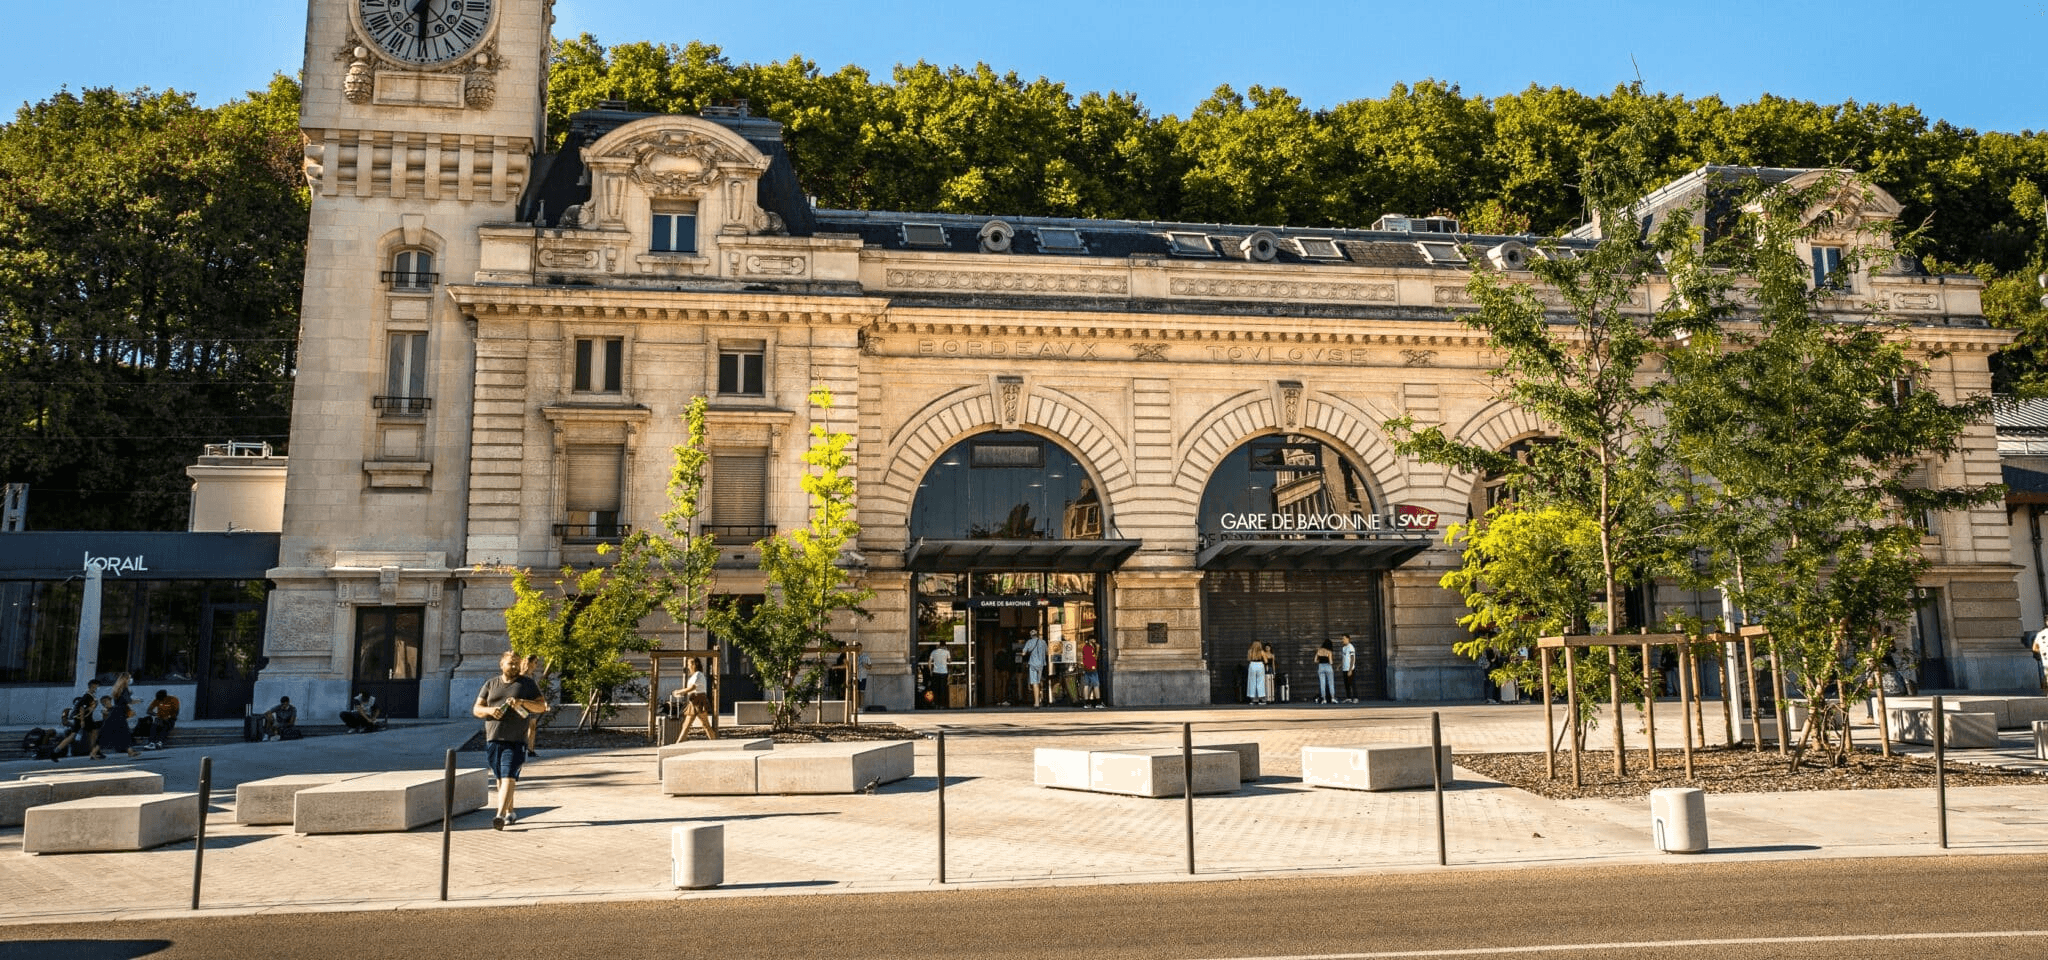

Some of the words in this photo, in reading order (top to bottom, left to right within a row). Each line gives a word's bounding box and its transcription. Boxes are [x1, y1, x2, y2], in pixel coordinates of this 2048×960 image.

[1220, 512, 1267, 530] GARE
[1271, 513, 1293, 530] DE
[1297, 513, 1381, 530] BAYONNE
[1398, 513, 1438, 527] SNCF
[83, 551, 148, 576] KORAIL
